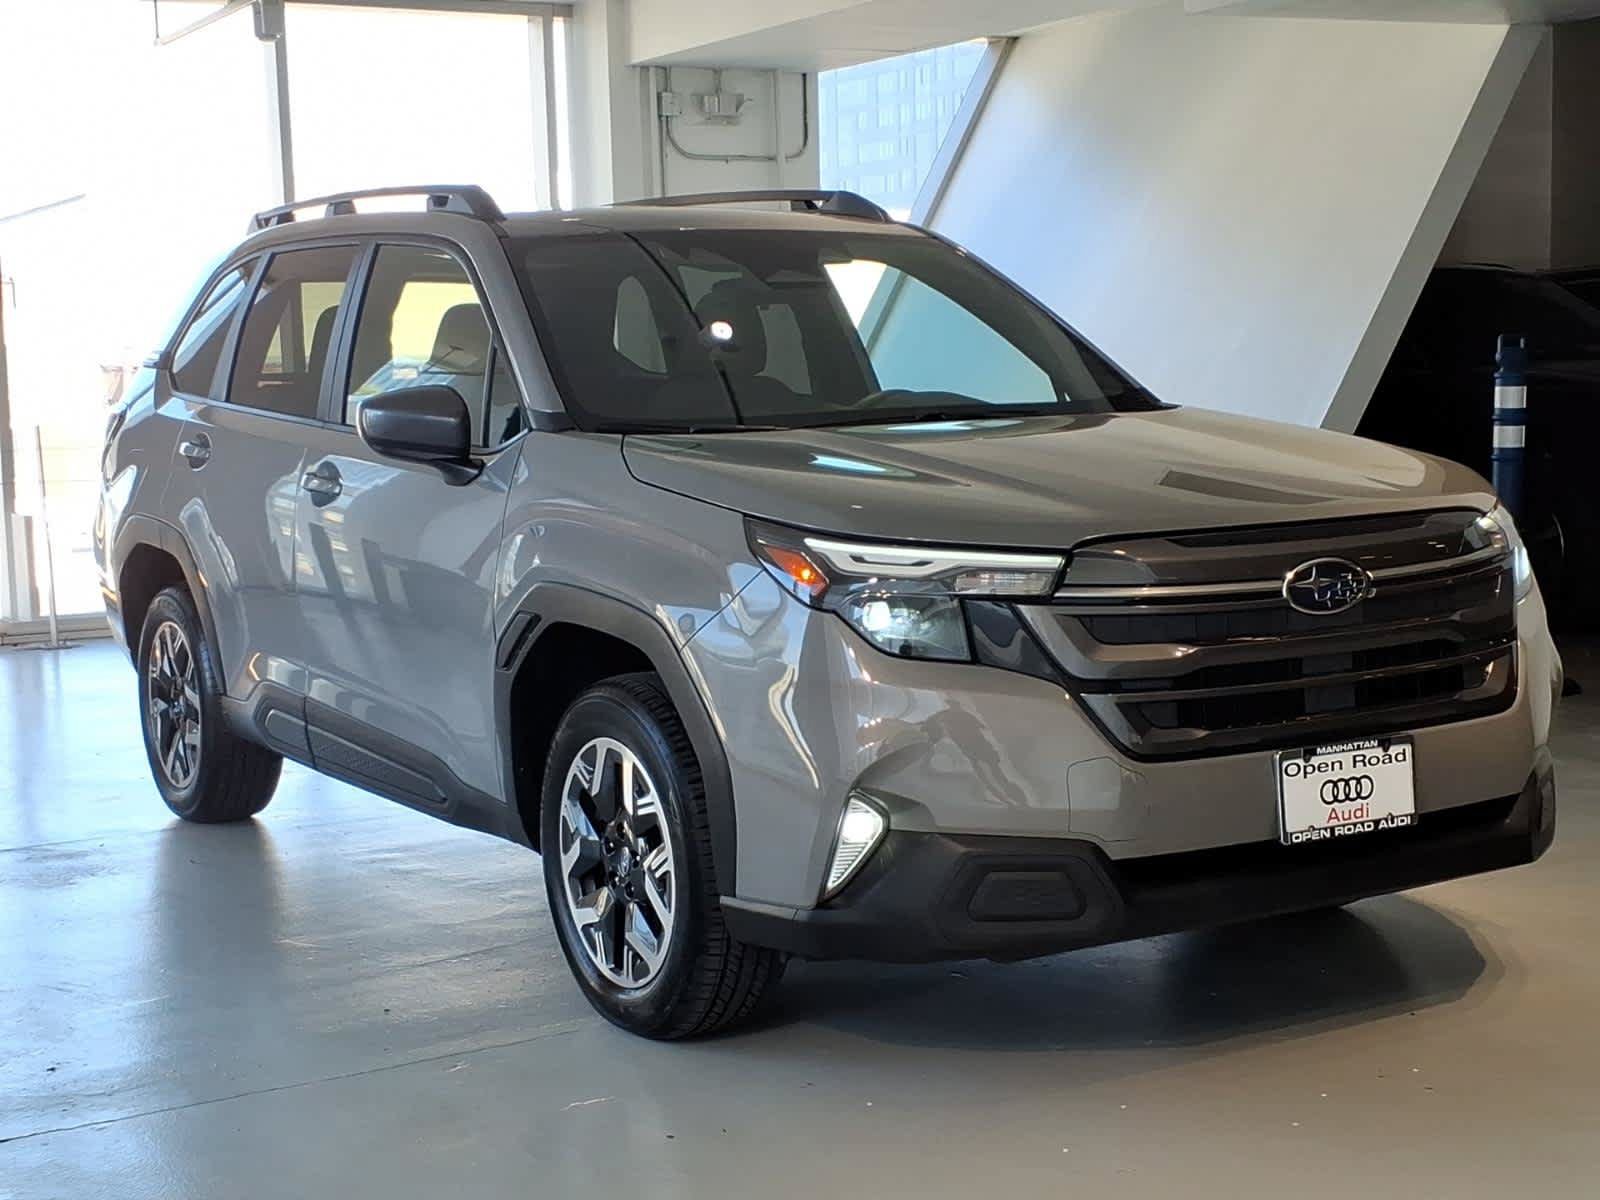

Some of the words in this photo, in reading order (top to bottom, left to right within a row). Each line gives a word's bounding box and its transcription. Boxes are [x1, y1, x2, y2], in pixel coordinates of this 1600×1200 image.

[1316, 740, 1378, 755] MANHATTAN
[1284, 759, 1343, 779] Open
[1352, 748, 1407, 768] Road
[1327, 803, 1370, 824] Audi
[1292, 828, 1331, 843] OPEN
[1335, 822, 1374, 837] ROAD
[1378, 816, 1411, 830] AUDI
